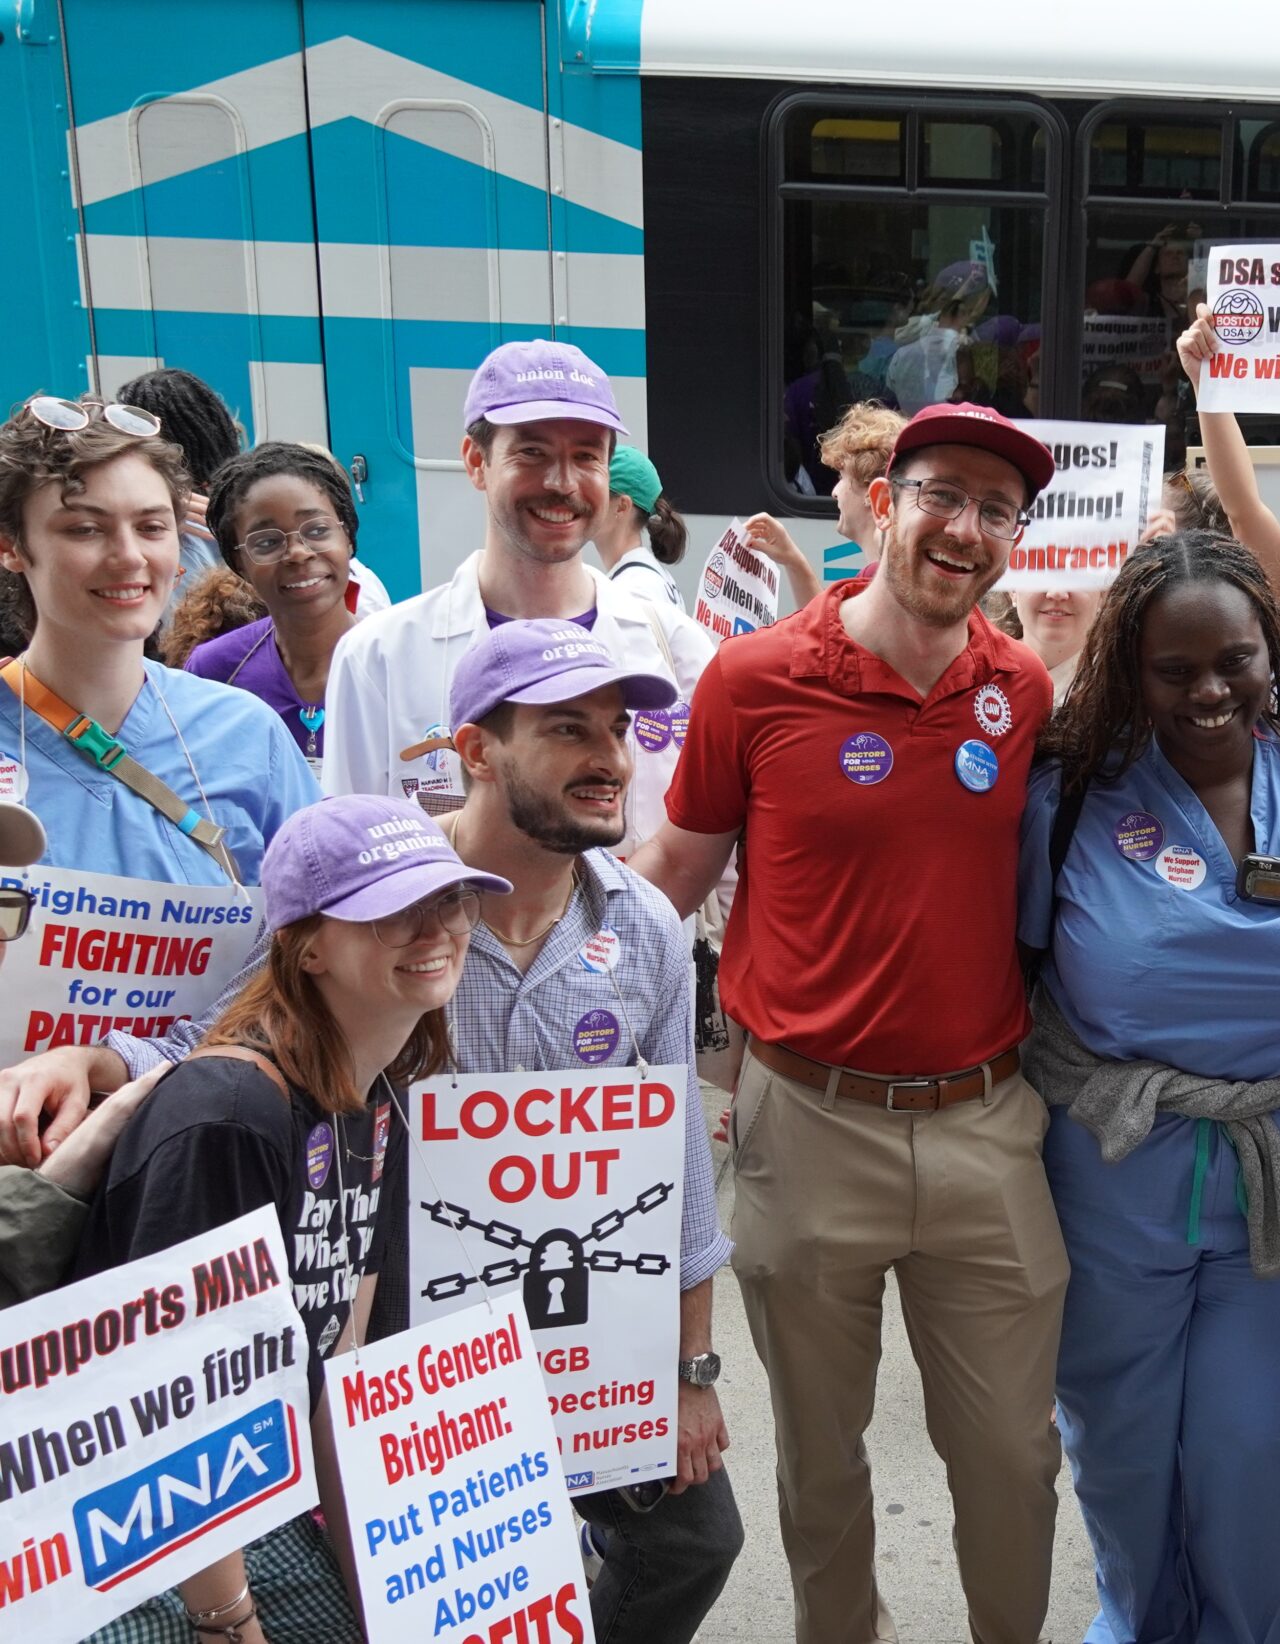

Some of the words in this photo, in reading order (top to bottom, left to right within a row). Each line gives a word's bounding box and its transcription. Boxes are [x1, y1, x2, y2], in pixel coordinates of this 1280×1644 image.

[1219, 258, 1265, 285] DSA
[1216, 316, 1260, 327] BOSTON
[1223, 328, 1244, 338] DSA
[516, 367, 565, 383] union
[570, 368, 597, 388] doc
[1209, 353, 1248, 379] We
[1045, 439, 1118, 472] ges!
[1009, 540, 1128, 571] ontract!
[722, 575, 753, 611] When
[696, 598, 711, 627] We
[713, 614, 732, 637] win
[984, 701, 1000, 715] UAW
[845, 751, 886, 759] DOCTORS
[847, 764, 881, 772] NURSES
[962, 759, 989, 777] MNA
[367, 815, 426, 839] union
[1118, 826, 1156, 839] DOCTORS
[1118, 837, 1134, 845] FOR
[1123, 840, 1154, 851] NURSES
[1167, 865, 1195, 875] Brigham
[1174, 856, 1200, 866] Support
[1168, 875, 1192, 883] Nurses!
[161, 898, 253, 925] Nurses
[39, 923, 213, 976] FIGHTING
[68, 979, 117, 1006] for
[126, 988, 176, 1008] our
[576, 1038, 592, 1047] FOR
[578, 1027, 615, 1039] DOCTORS
[579, 1043, 609, 1053] NURSES
[421, 1081, 676, 1141] LOCKED
[488, 1148, 620, 1204] OUT
[298, 1190, 339, 1237] Pay
[294, 1230, 350, 1272] What
[0, 1283, 184, 1395] upports
[192, 1237, 280, 1318] MNA
[342, 1363, 415, 1428] Mass
[417, 1313, 523, 1396] General
[537, 1346, 590, 1376] GB
[549, 1379, 654, 1416] pecting
[0, 1404, 126, 1499] When
[130, 1375, 194, 1439] we
[202, 1325, 296, 1405] fight
[379, 1396, 513, 1486] Brigham:
[573, 1417, 669, 1453] nurses
[86, 1432, 273, 1567] MNA
[253, 1416, 274, 1434] SM
[567, 1475, 590, 1487] NA
[365, 1504, 423, 1557] Put
[428, 1450, 549, 1527] Patients
[384, 1544, 446, 1604] and
[452, 1501, 553, 1570] Nurses
[433, 1565, 530, 1638] Above
